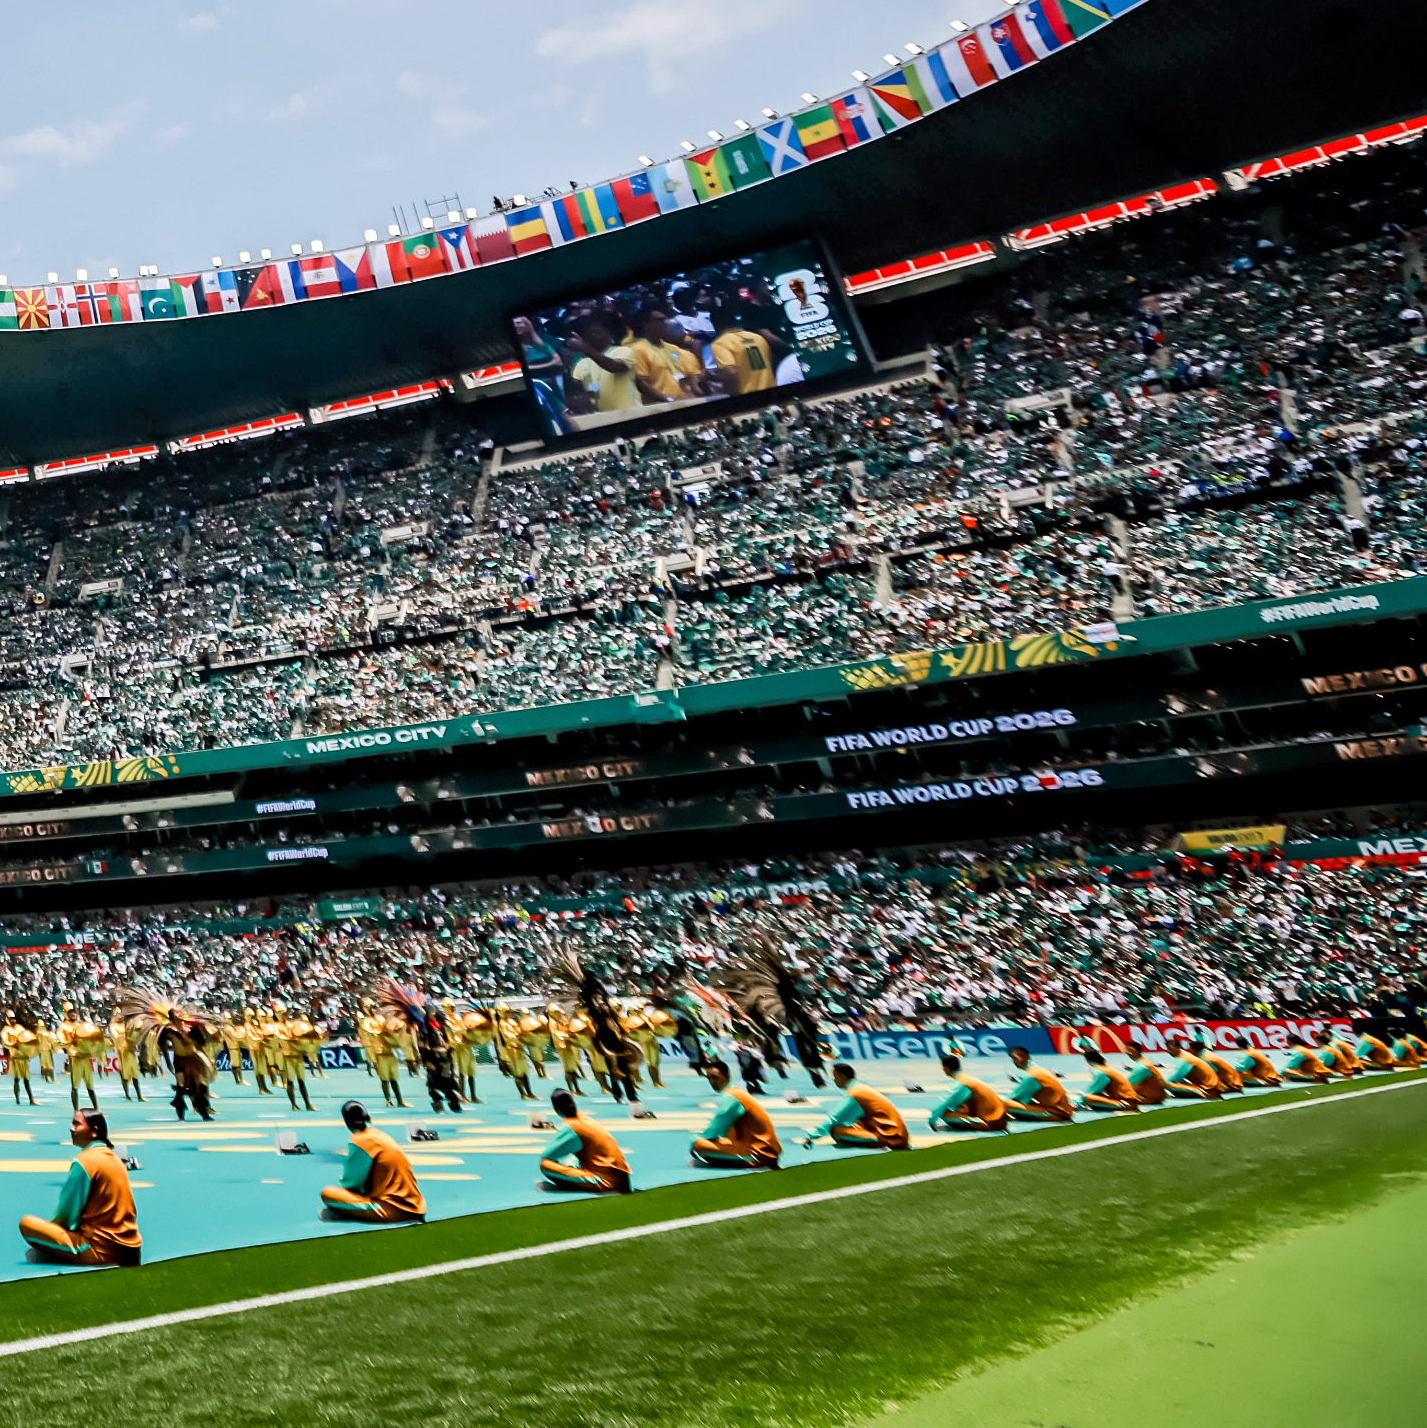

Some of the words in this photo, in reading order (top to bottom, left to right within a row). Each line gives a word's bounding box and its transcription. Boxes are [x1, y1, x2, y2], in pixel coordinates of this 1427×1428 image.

[792, 322, 820, 332] WORLD
[820, 318, 834, 327] CUP
[795, 324, 837, 340] 2026
[306, 731, 391, 754] MEXICO
[395, 725, 447, 743] CITY
[824, 734, 873, 753] FIFA
[871, 724, 948, 747] WORLD
[948, 718, 993, 738] CUP
[995, 708, 1078, 732] 2026
[846, 792, 895, 809] FIFA
[894, 782, 973, 805] WORLD
[974, 777, 1019, 797] CUP
[255, 799, 316, 814] #FIFAWorldCup
[542, 818, 617, 838] MEXO
[619, 814, 658, 831] CIT
[267, 846, 329, 861] #FIFAWorldCup
[44, 867, 72, 880] CIT
[827, 1031, 1008, 1060] Hisense
